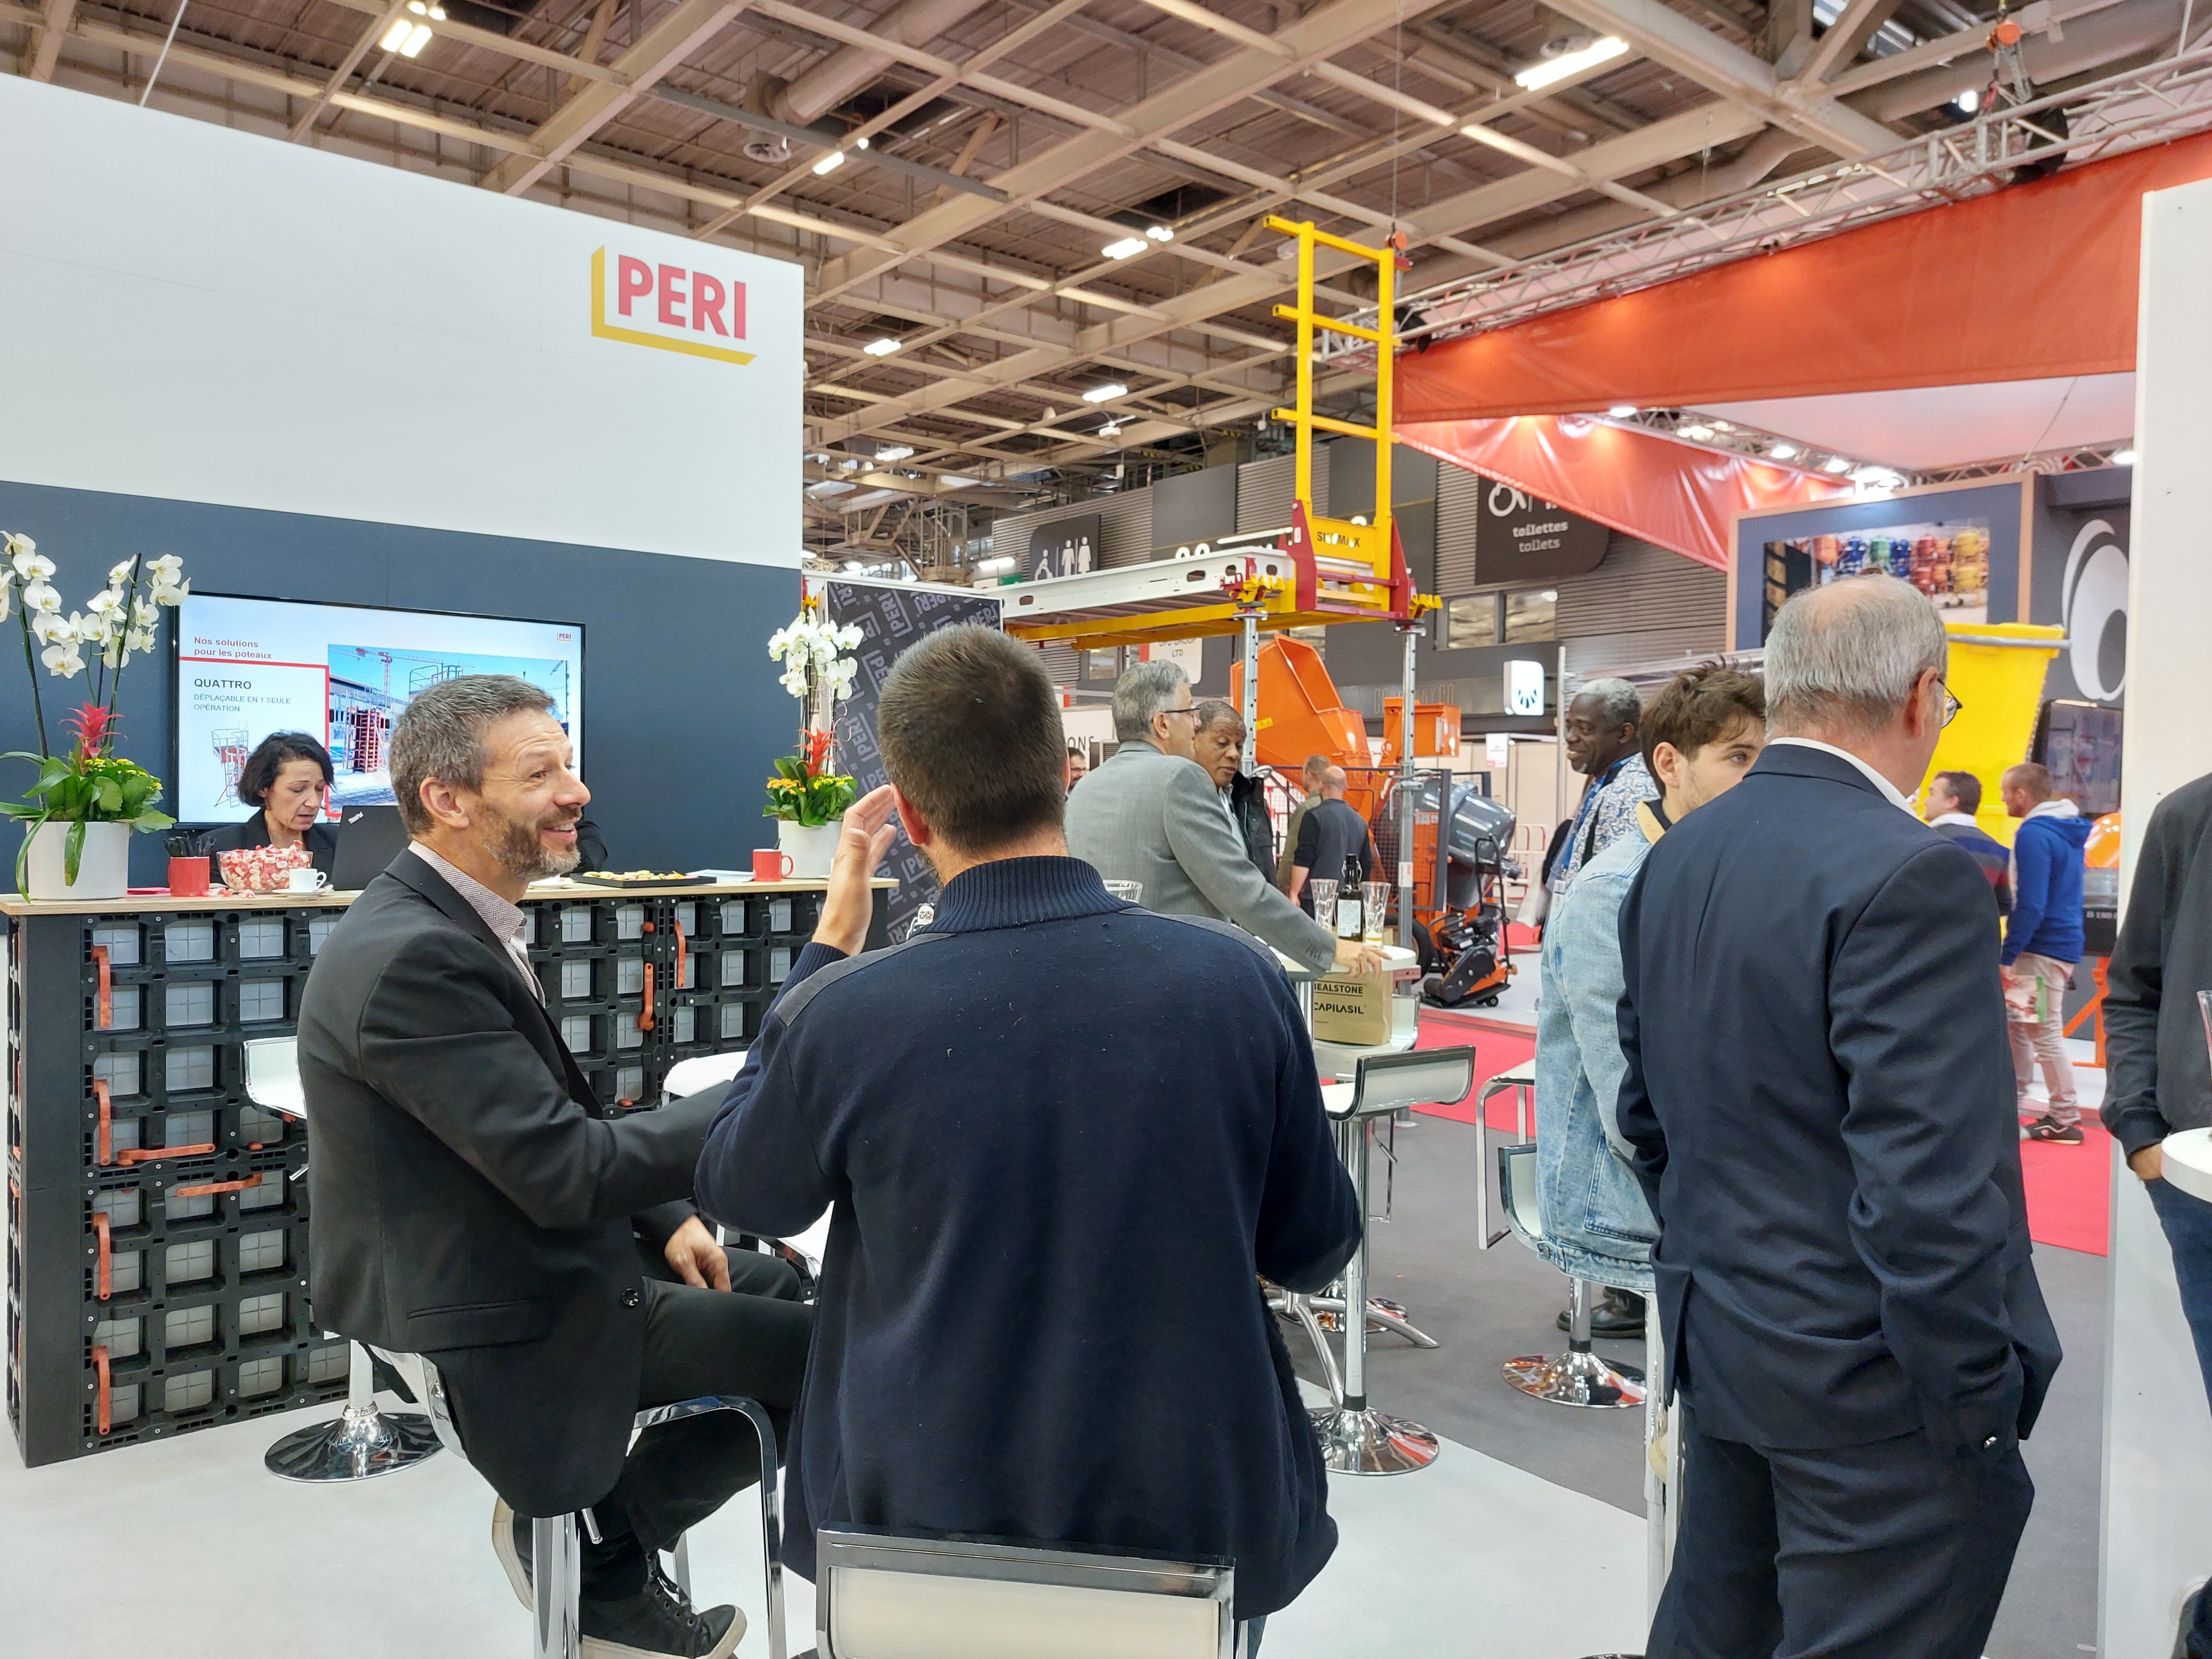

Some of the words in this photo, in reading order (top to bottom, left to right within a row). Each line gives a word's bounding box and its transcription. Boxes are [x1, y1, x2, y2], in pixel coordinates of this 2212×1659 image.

[619, 254, 746, 340] PERI
[1512, 521, 1569, 537] toilettes
[1317, 531, 1360, 547] SKMAX
[1518, 539, 1561, 553] toilets
[878, 592, 905, 633] PERI
[194, 637, 212, 645] Nos
[216, 639, 258, 648] solutions
[235, 651, 272, 659] poteaux
[1172, 649, 1183, 657] LTD
[194, 678, 252, 689] QUATTRO
[194, 693, 245, 702] DÉPLAÇABLE
[194, 703, 240, 712] OPÉRATION
